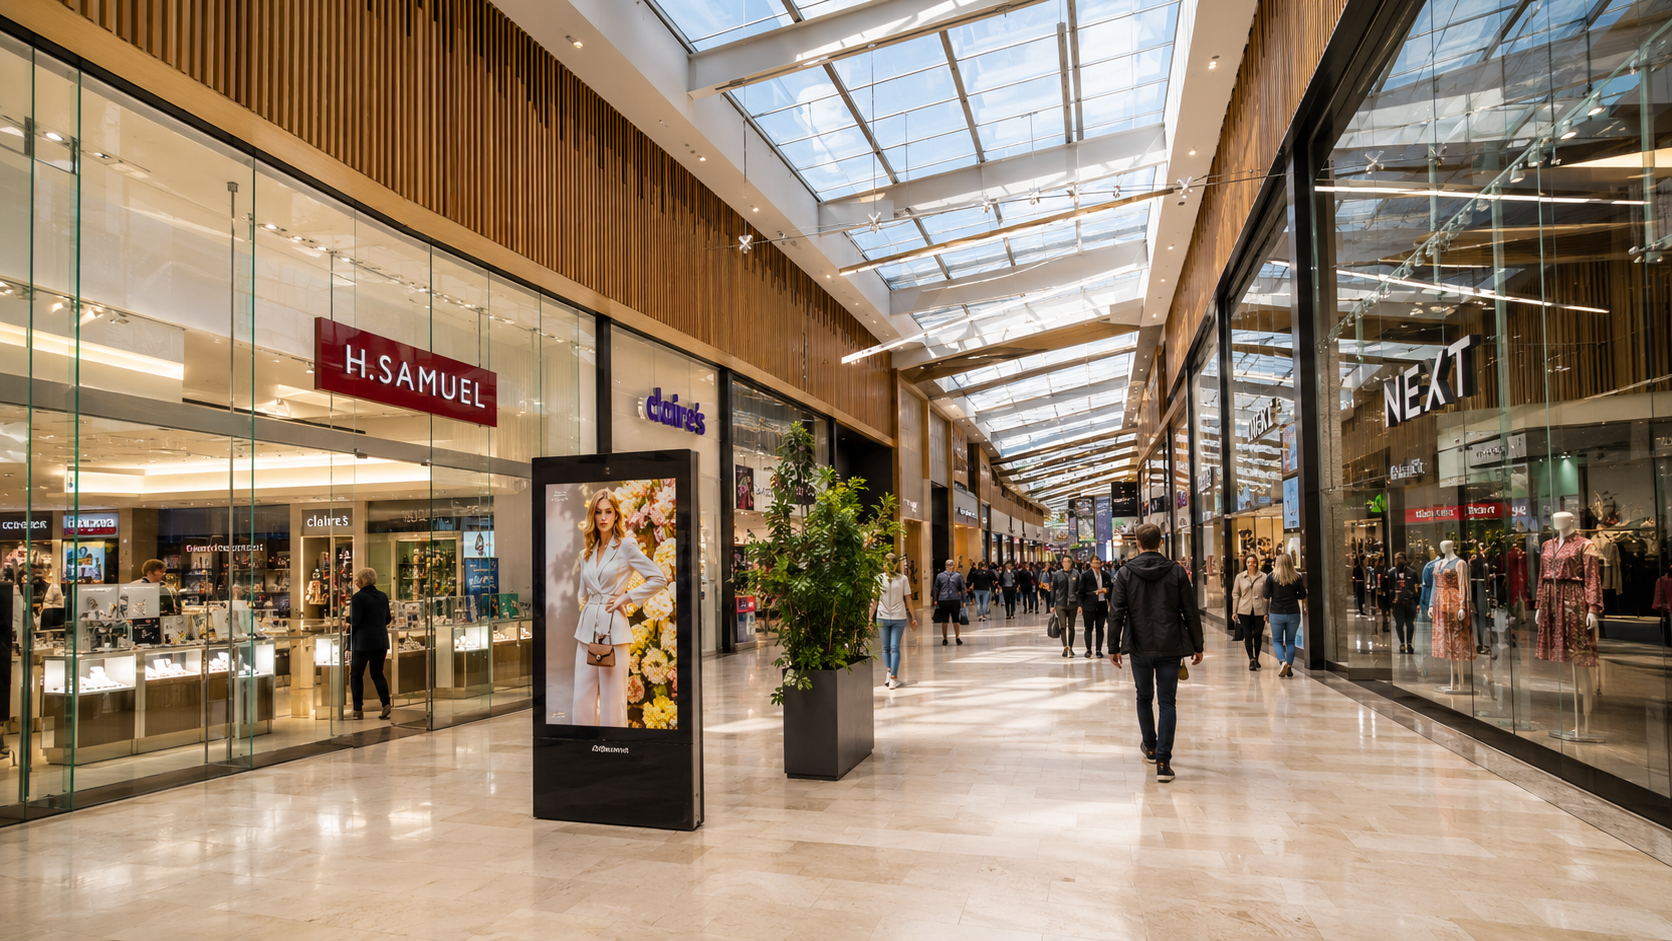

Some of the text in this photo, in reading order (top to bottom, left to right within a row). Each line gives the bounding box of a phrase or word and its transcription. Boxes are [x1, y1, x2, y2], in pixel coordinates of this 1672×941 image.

[345, 344, 486, 410] H.SAMUEL
[1384, 335, 1478, 428] NEXT
[647, 386, 706, 436] claire's
